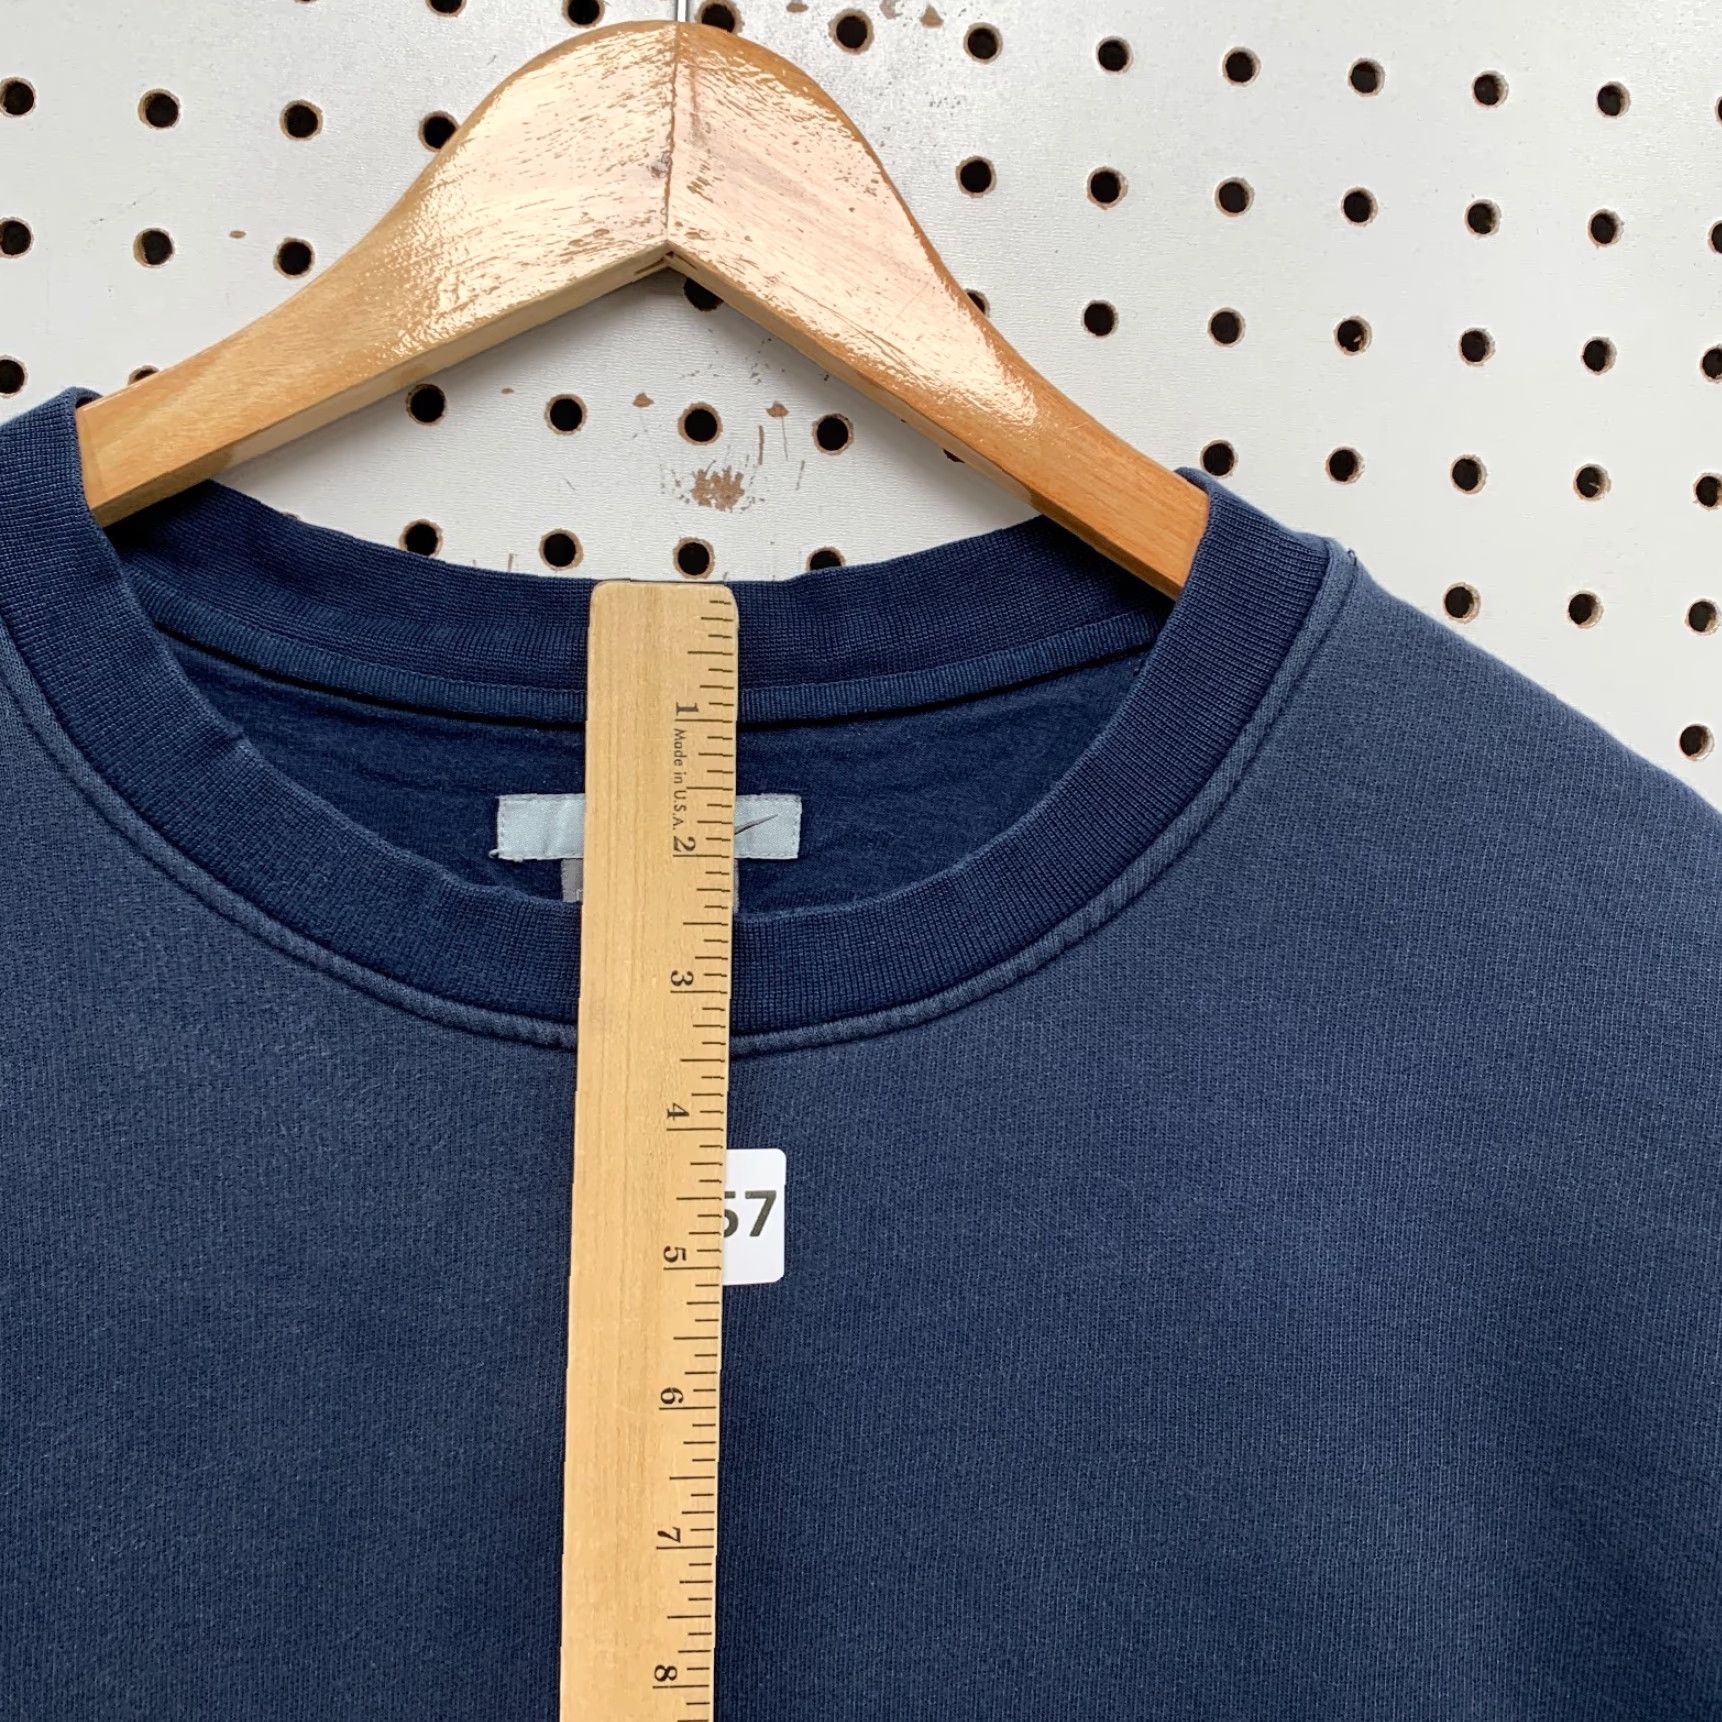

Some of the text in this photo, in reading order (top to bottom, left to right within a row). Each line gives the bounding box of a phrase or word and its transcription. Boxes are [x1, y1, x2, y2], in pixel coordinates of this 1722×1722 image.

[675, 702, 699, 716] 1
[672, 728, 688, 831] Made in U.S.A.
[673, 836, 697, 852] 2
[670, 970, 694, 987] 3
[666, 1102, 690, 1121] 4
[663, 1245, 687, 1263] 5
[660, 1386, 684, 1405] 6
[656, 1526, 681, 1543] 7
[654, 1664, 678, 1682] 8
